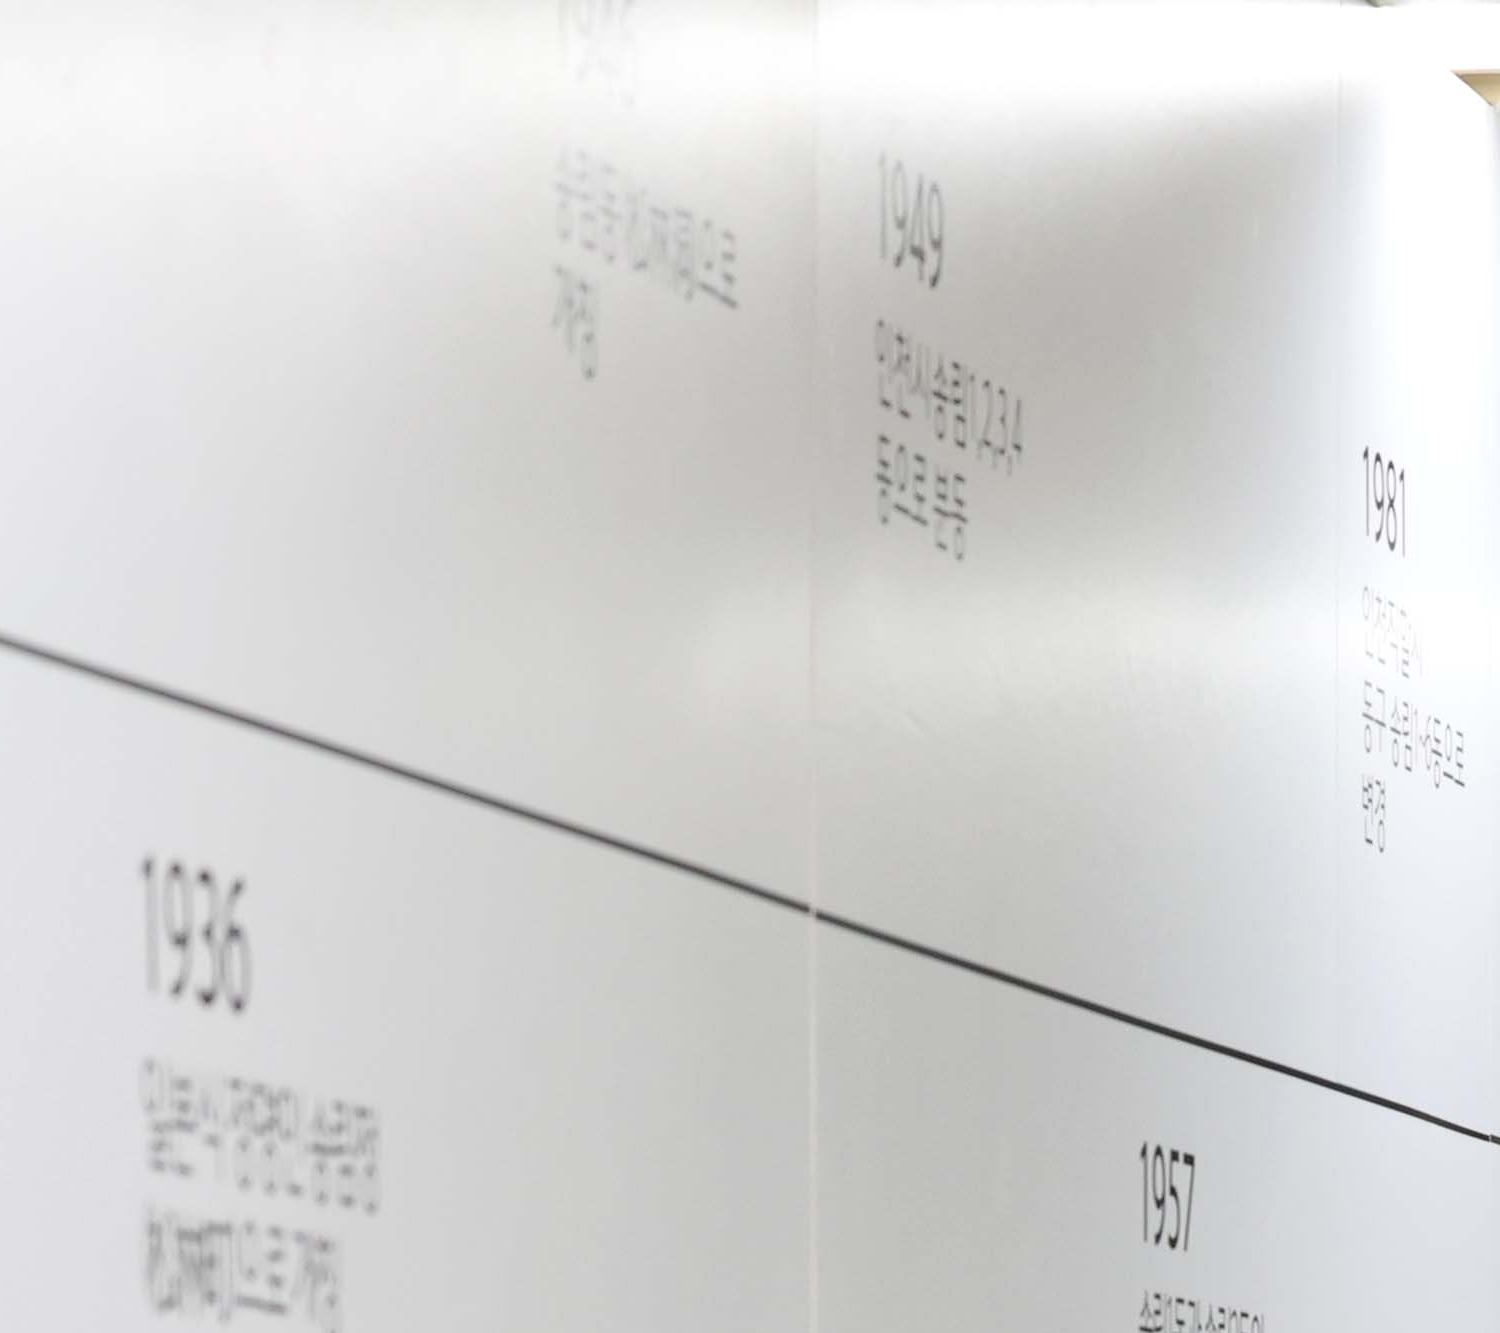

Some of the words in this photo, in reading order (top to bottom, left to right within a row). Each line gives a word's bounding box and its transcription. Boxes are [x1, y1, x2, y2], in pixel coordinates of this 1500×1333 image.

[878, 152, 944, 291] 1949
[874, 317, 930, 421] 인천시
[874, 433, 930, 528] 동으로
[932, 470, 969, 563] 분동
[1362, 446, 1405, 556] 1981
[1361, 584, 1425, 682] 인천직할시
[1361, 680, 1387, 754] 동구
[1389, 696, 1466, 789] 송림1~6동으로
[1362, 773, 1386, 854] 변경
[140, 853, 251, 1017] 1936
[138, 1055, 222, 1178] 일본식
[1139, 1141, 1196, 1251] 1957
